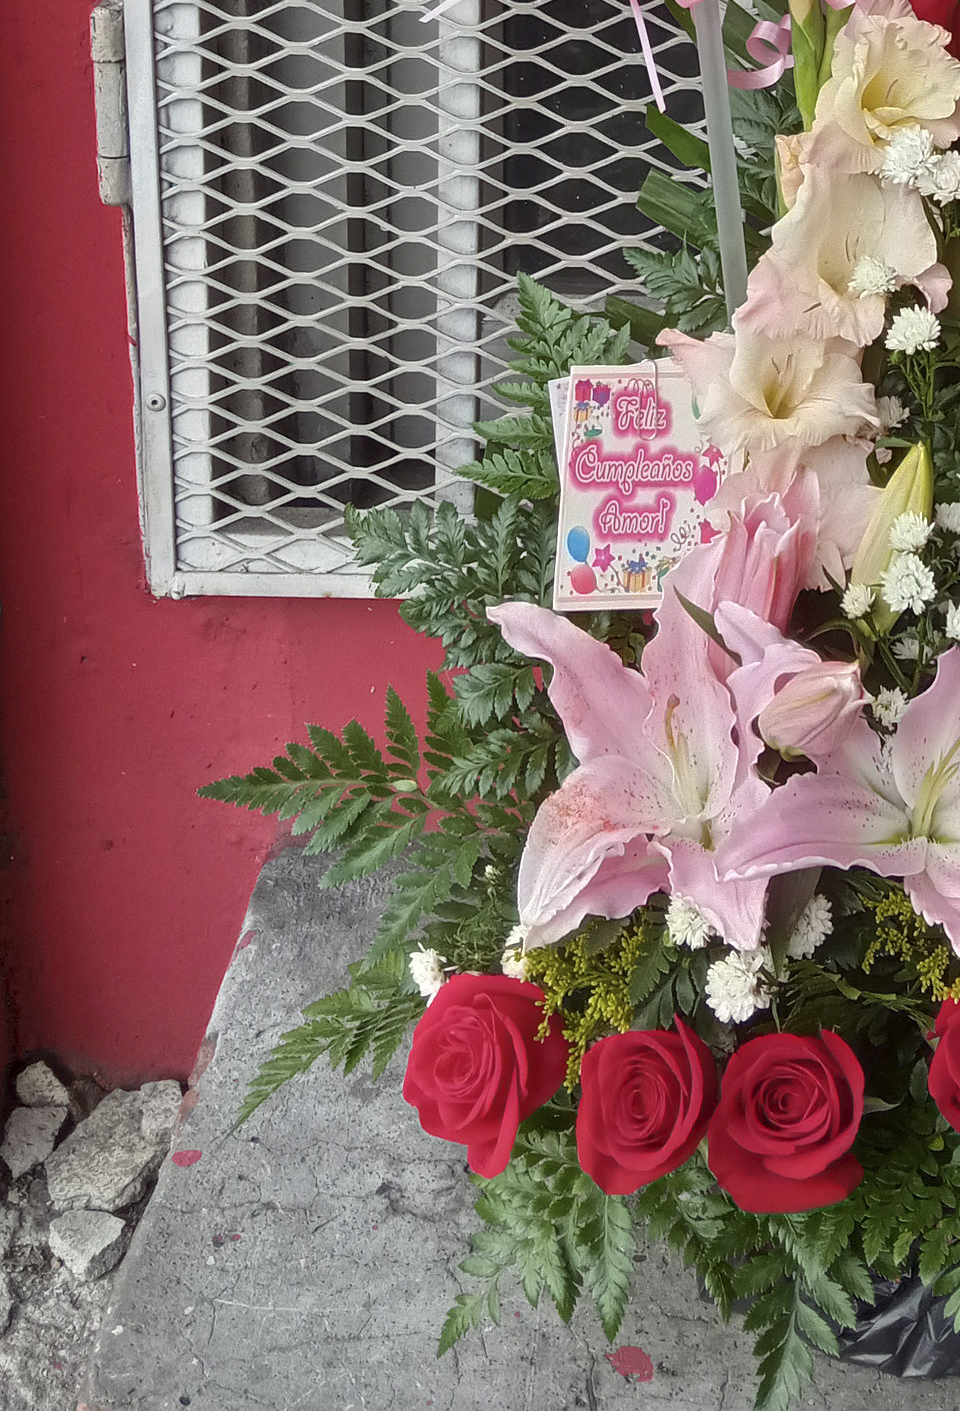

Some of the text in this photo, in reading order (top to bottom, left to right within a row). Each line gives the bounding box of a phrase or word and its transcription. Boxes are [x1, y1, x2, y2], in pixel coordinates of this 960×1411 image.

[617, 396, 667, 431] Feliz
[576, 445, 693, 495] Cumpleaños
[600, 499, 670, 534] Amor!
